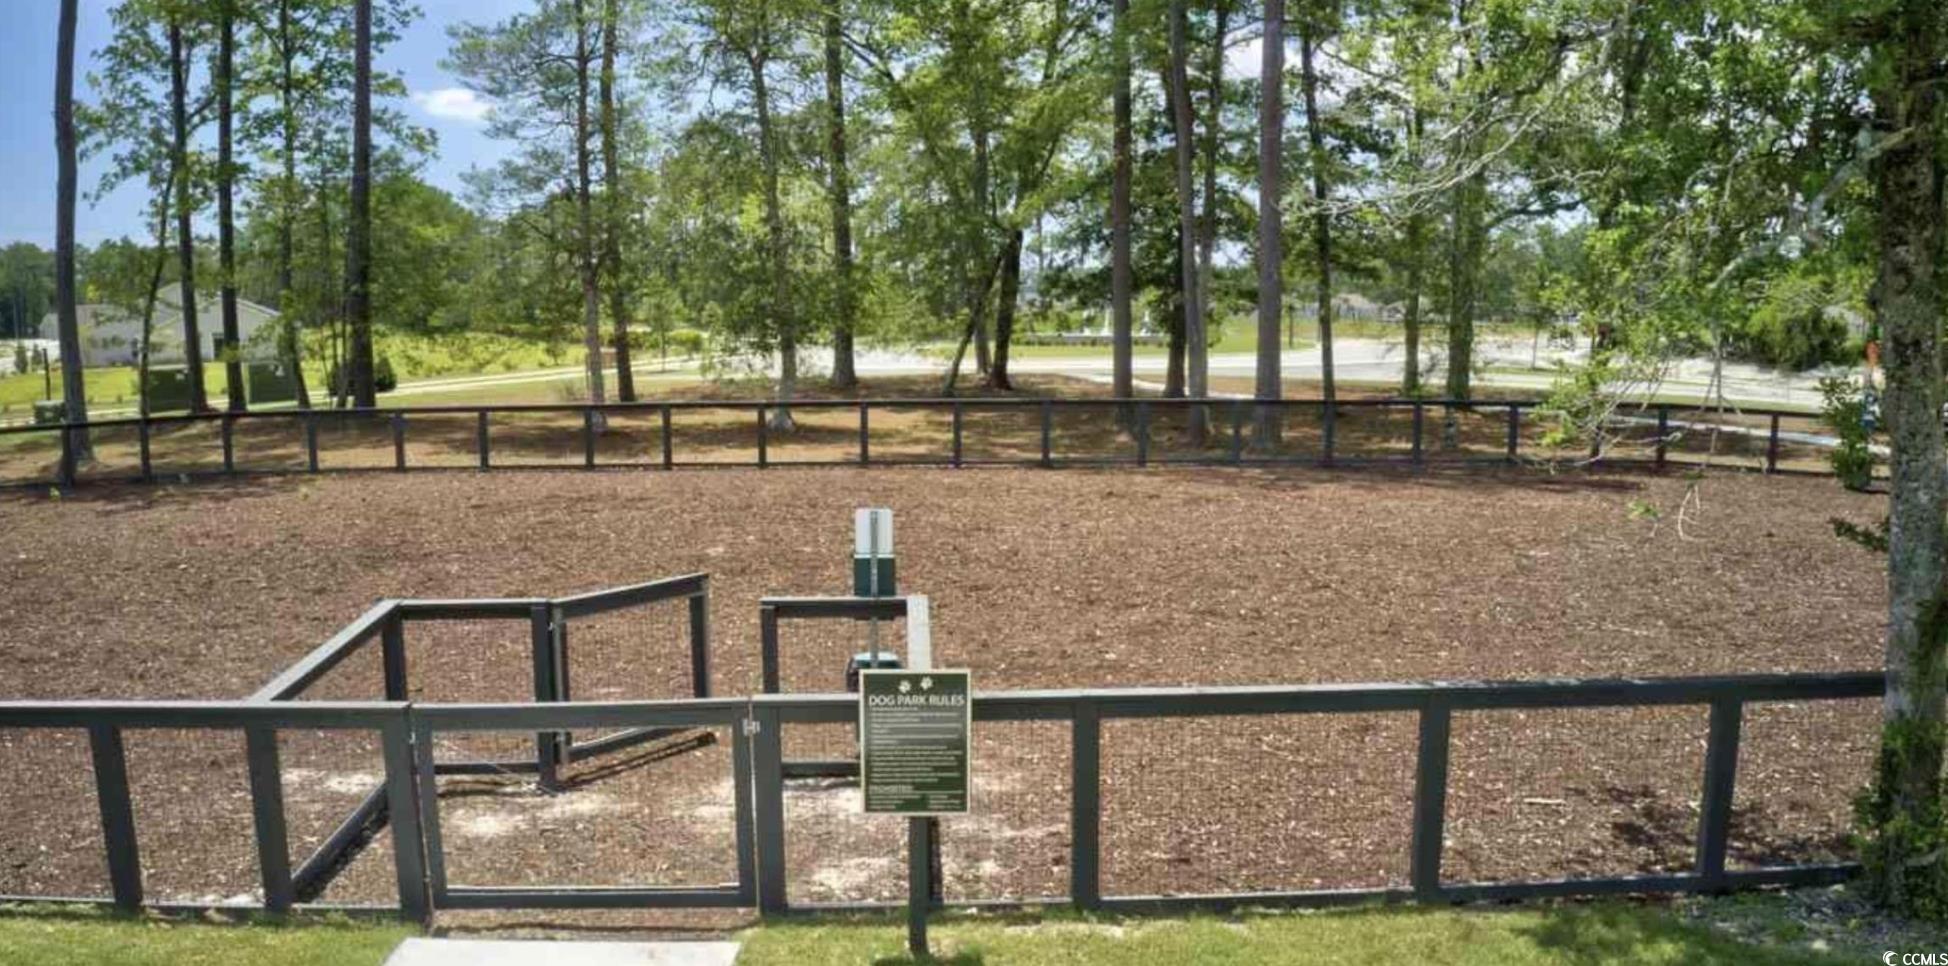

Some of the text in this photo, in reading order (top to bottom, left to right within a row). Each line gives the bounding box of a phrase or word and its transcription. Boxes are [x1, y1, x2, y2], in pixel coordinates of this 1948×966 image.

[869, 695, 965, 706] DOG PARK RULES
